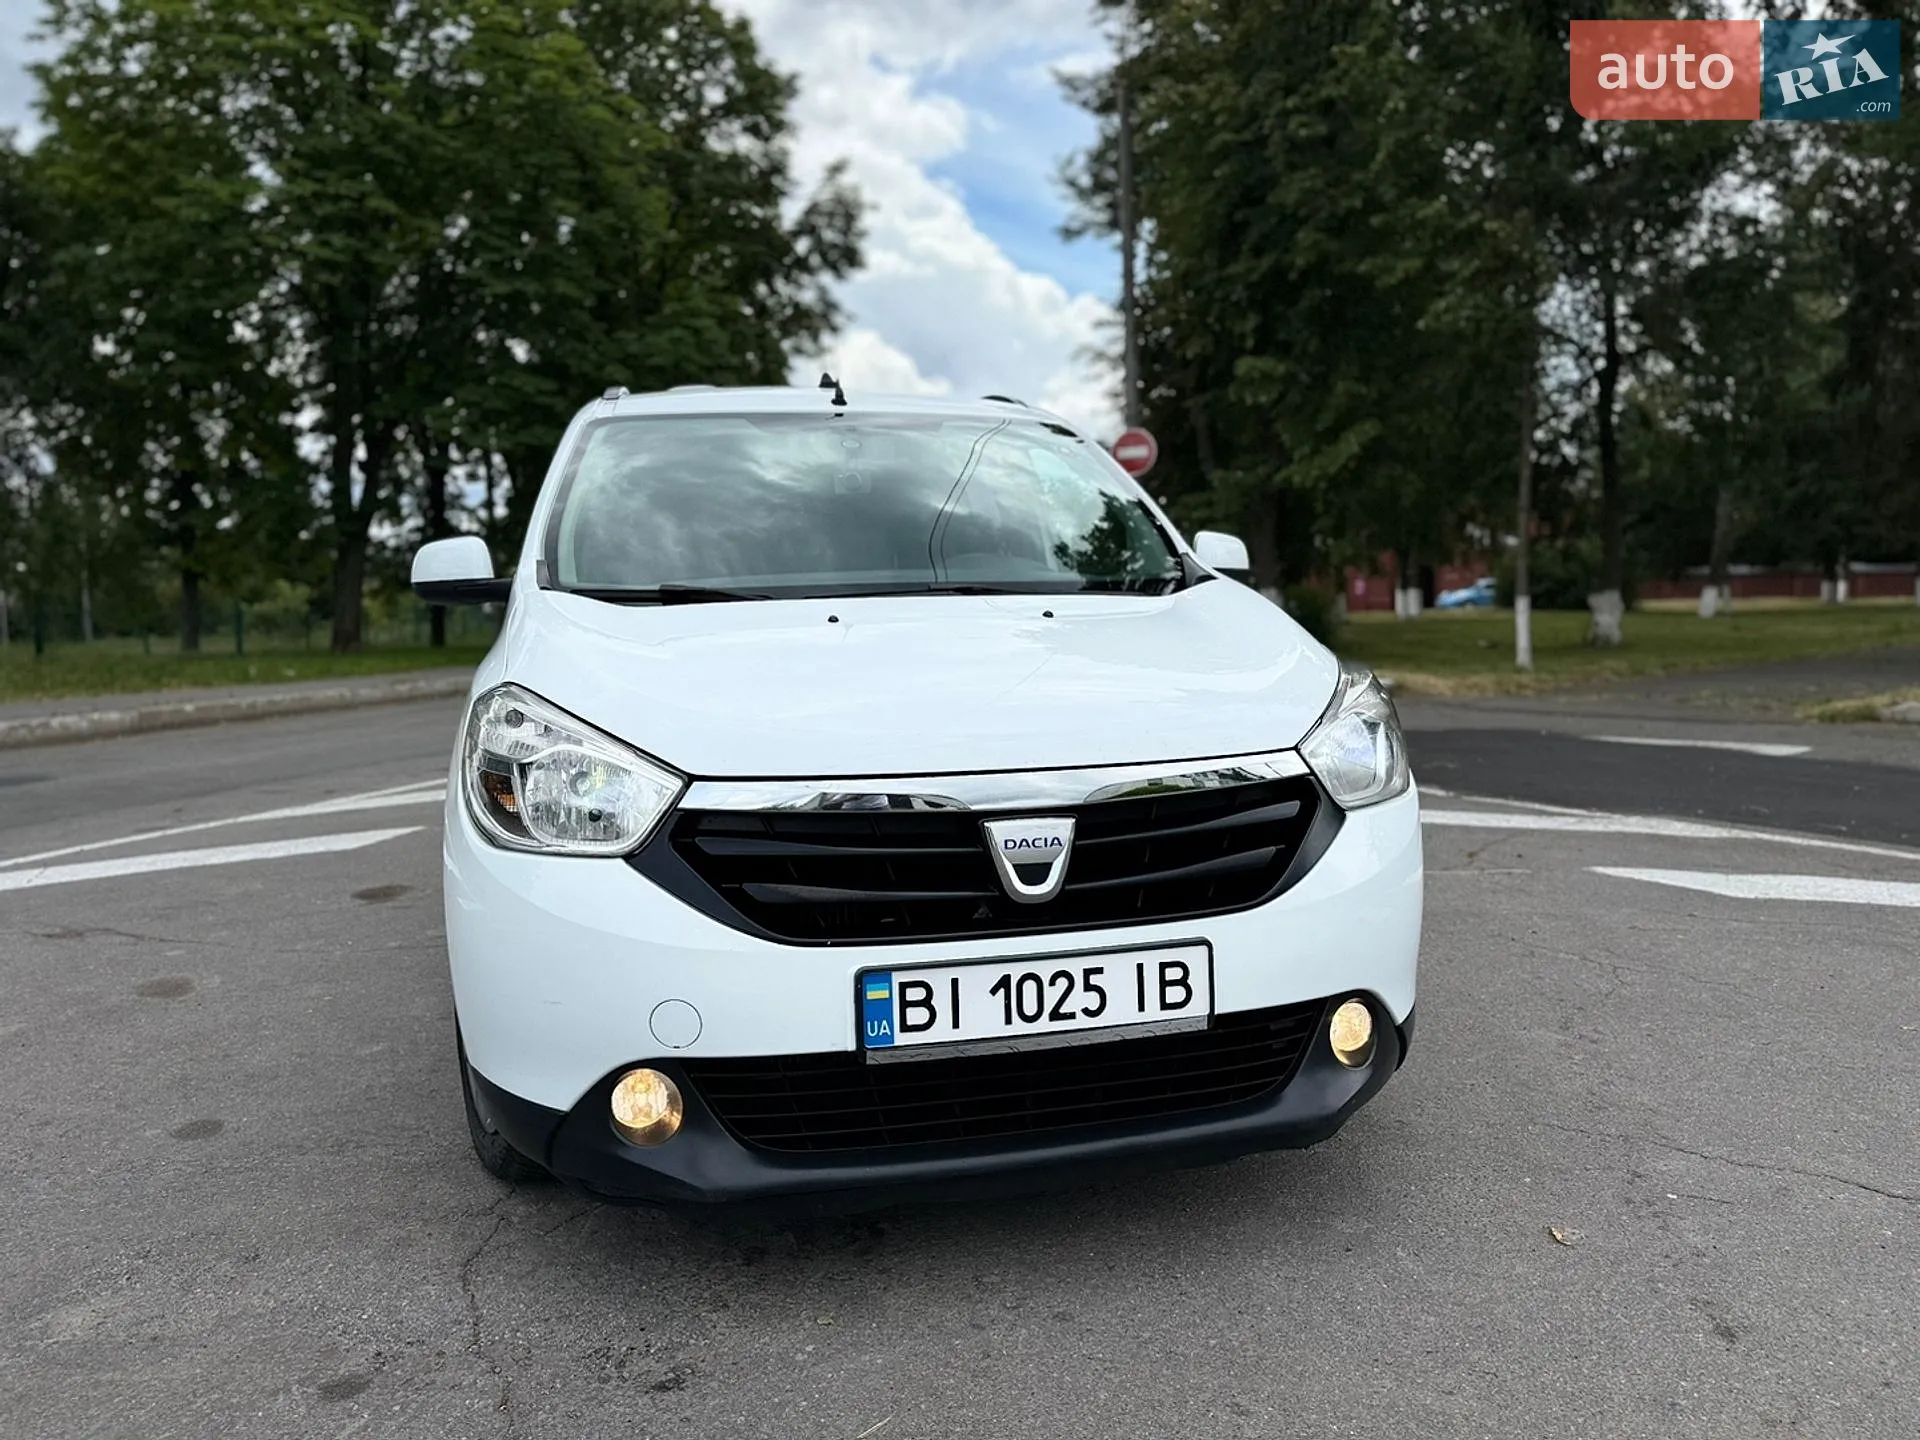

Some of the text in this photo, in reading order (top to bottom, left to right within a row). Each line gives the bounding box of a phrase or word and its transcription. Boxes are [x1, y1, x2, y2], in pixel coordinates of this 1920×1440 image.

[1003, 836, 1063, 850] DACIA
[898, 960, 1193, 1034] BI 1025 IB
[866, 1019, 891, 1038] UA
